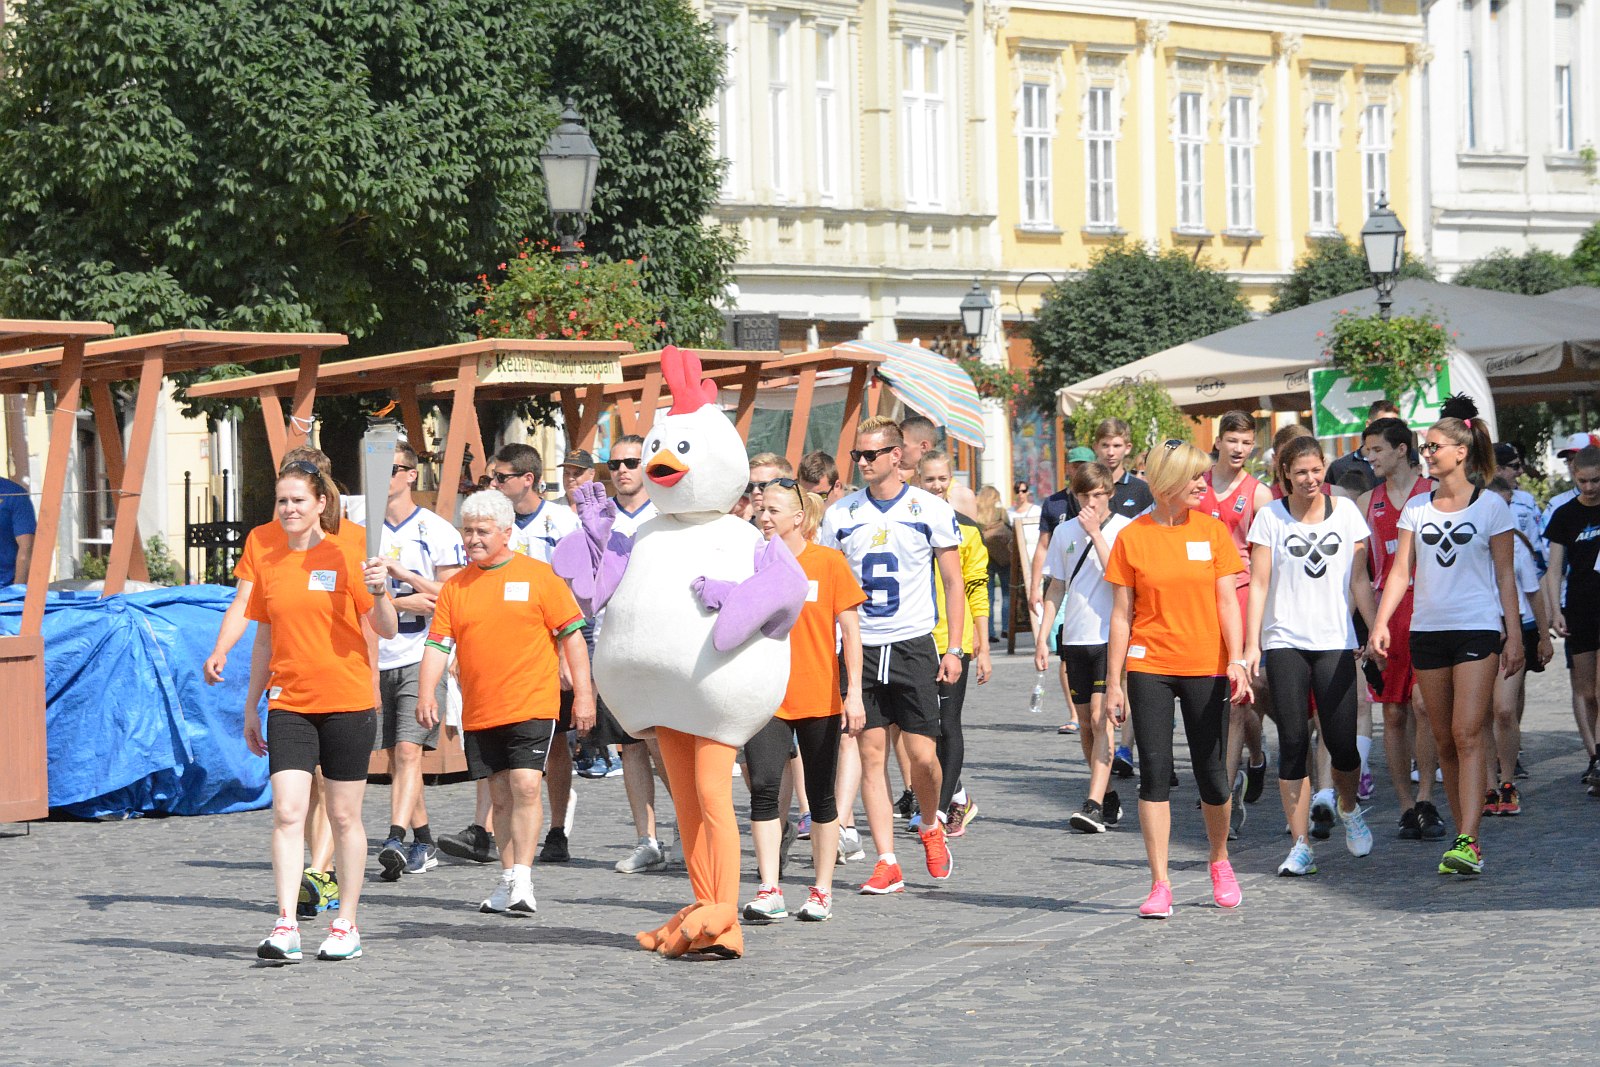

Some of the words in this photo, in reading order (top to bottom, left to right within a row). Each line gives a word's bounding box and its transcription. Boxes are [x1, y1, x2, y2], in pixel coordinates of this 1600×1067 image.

[743, 318, 775, 329] BOOK
[744, 329, 775, 340] LIVRE
[861, 552, 900, 617] 6
